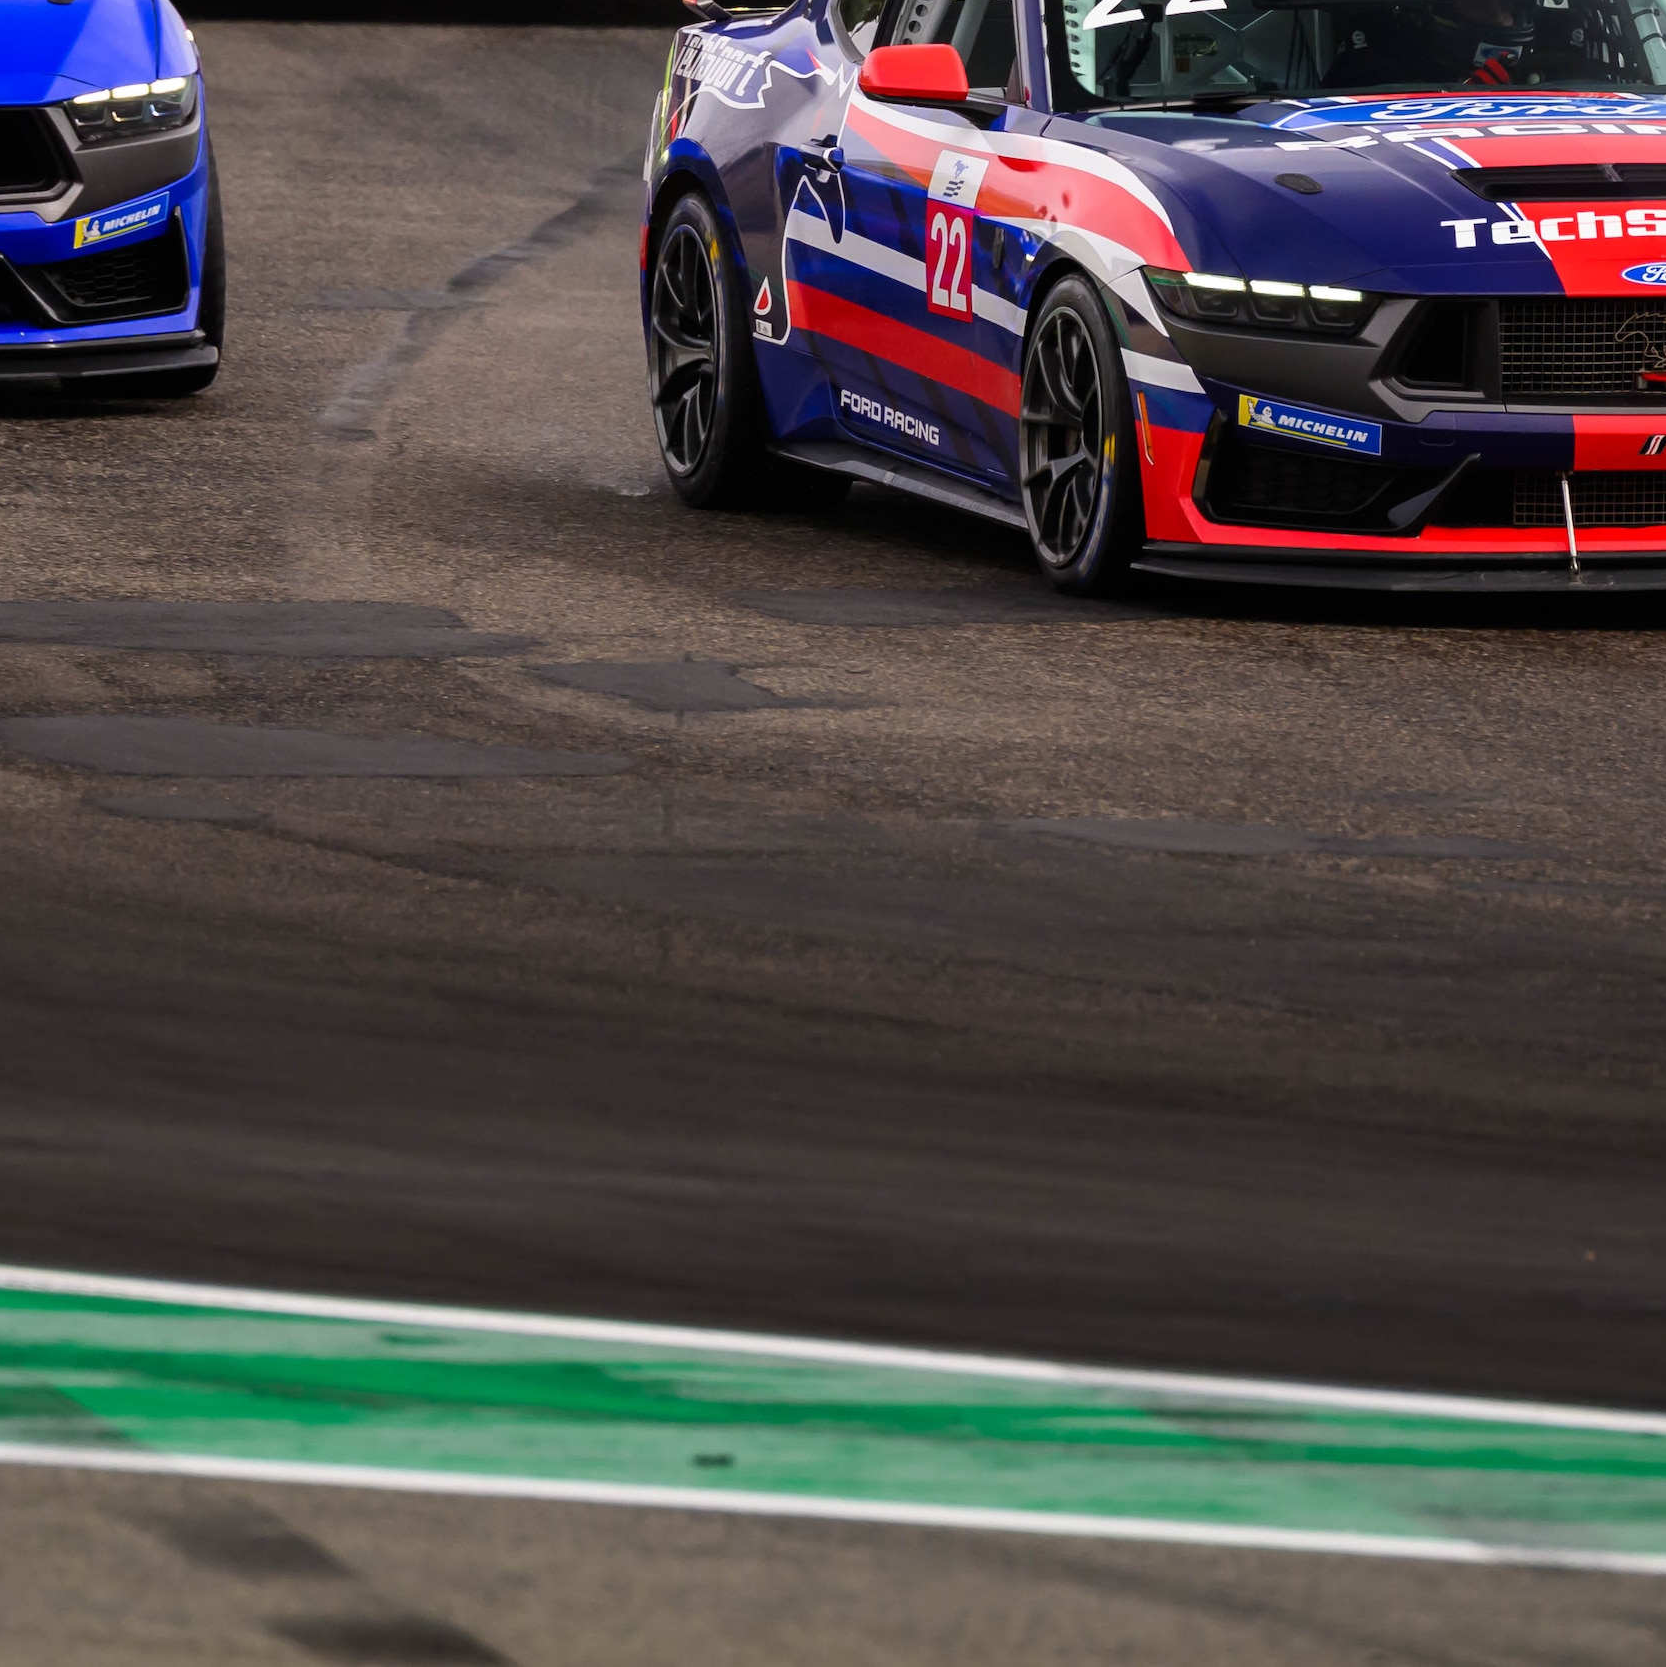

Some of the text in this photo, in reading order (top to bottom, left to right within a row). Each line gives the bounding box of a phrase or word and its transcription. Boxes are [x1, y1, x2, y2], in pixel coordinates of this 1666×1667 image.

[1367, 96, 1661, 122] Ford
[102, 204, 162, 232] MICHELIN
[931, 211, 968, 314] 22
[840, 389, 940, 446] FORD RACING
[1277, 414, 1370, 444] MICHELIN
